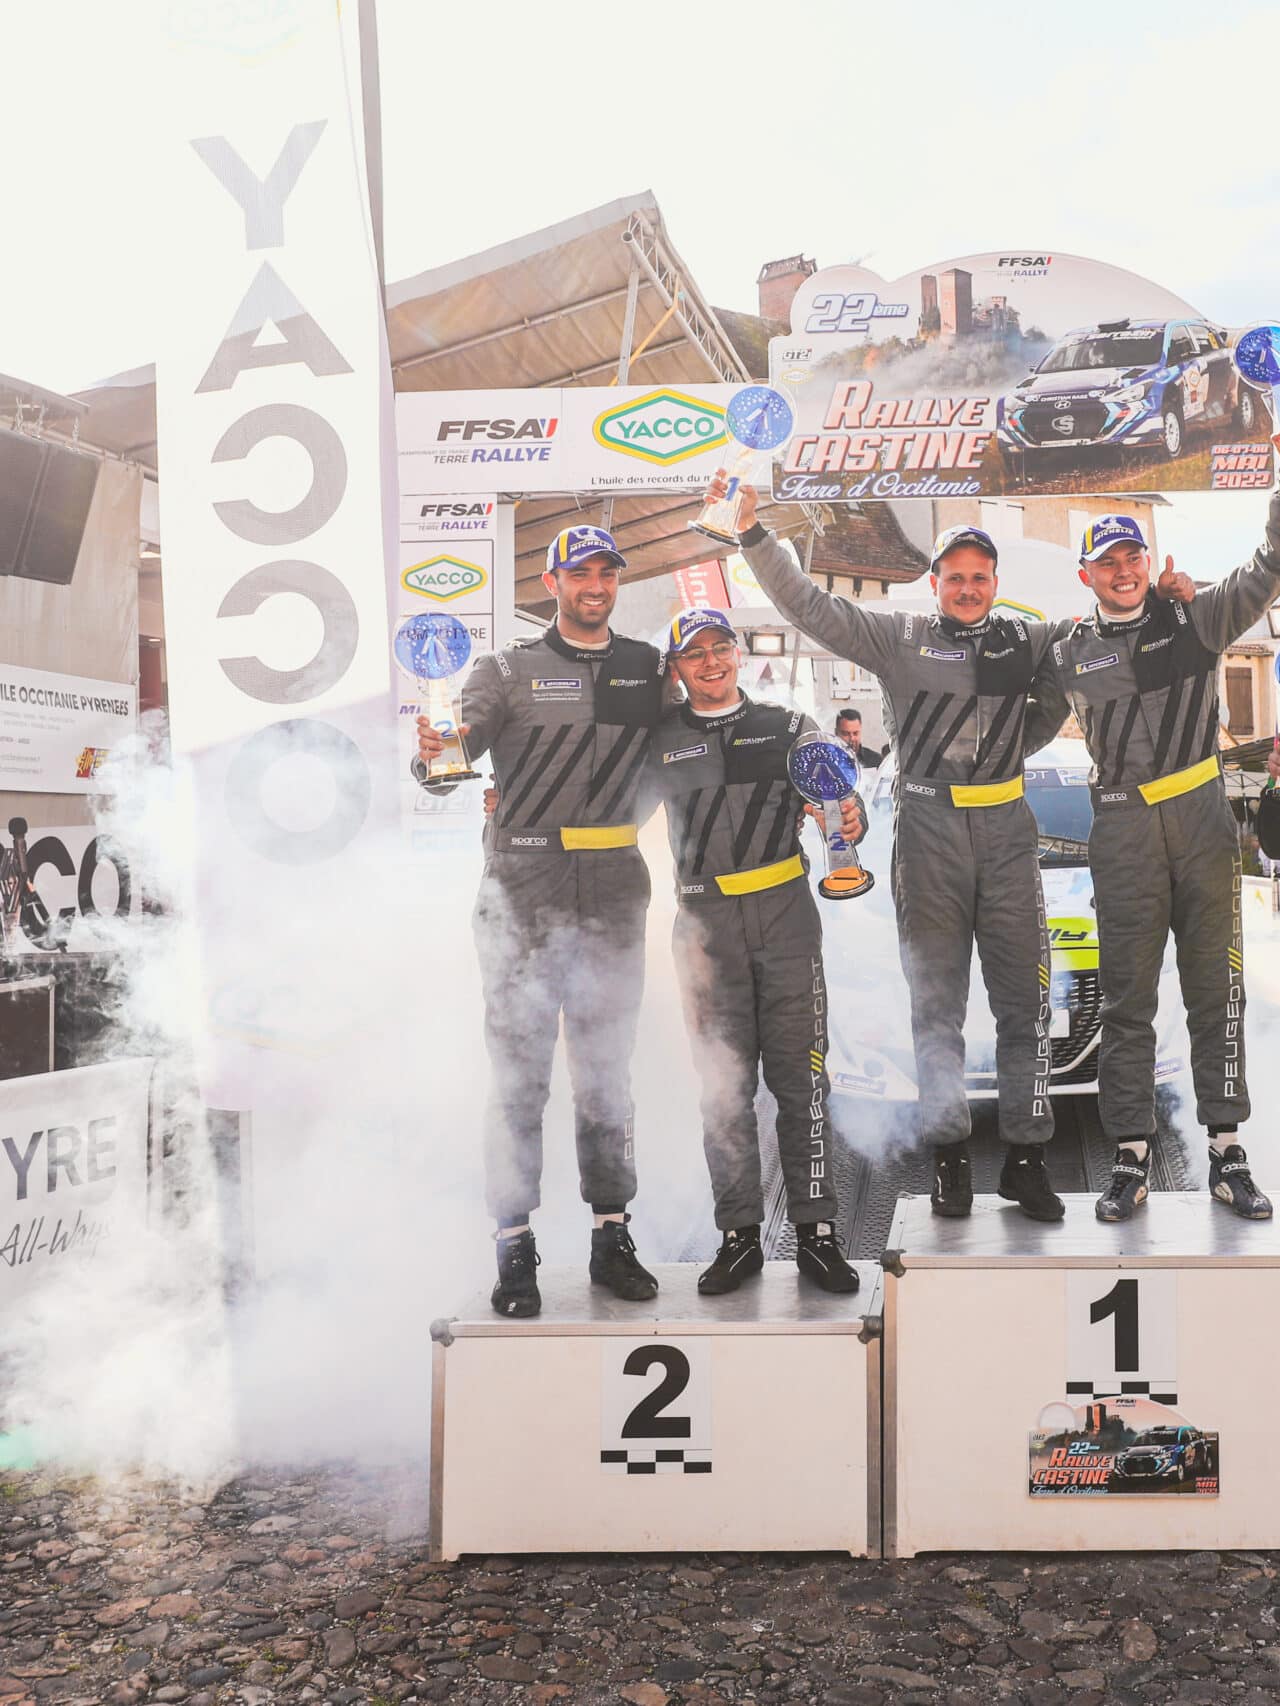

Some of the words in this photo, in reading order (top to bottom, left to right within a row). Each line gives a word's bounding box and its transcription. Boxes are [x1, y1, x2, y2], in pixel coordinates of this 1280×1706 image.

[437, 418, 545, 441] FFSA
[616, 416, 715, 439] YACCO
[433, 455, 469, 465] TERRE
[471, 447, 552, 463] RALLYE
[783, 431, 992, 473] CASTINE
[1213, 455, 1270, 471] MAI
[627, 474, 644, 484] des
[647, 474, 685, 484] records
[687, 474, 700, 482] du
[726, 476, 740, 501] 1
[776, 474, 842, 500] Terre
[847, 472, 981, 498] d'Occitanie
[1214, 473, 1270, 489] 2022
[421, 503, 485, 516] FFSA
[440, 520, 488, 531] RALLYE
[569, 540, 613, 553] MICHELIN
[415, 572, 474, 586] YACCO
[18, 685, 80, 711] OCCITANIE
[434, 719, 457, 738] 2
[511, 836, 548, 846] sparco
[828, 832, 849, 851] 2
[811, 957, 825, 1051] SPORT
[1224, 968, 1241, 1098] PEUGEOT
[1032, 985, 1049, 1117] PEUGEOT
[810, 1071, 825, 1199] PEUGEOT
[1, 1115, 117, 1201] YRE
[1089, 1279, 1139, 1372] 1
[621, 1344, 691, 1438] 2
[1032, 1468, 1114, 1485] CASTINE
